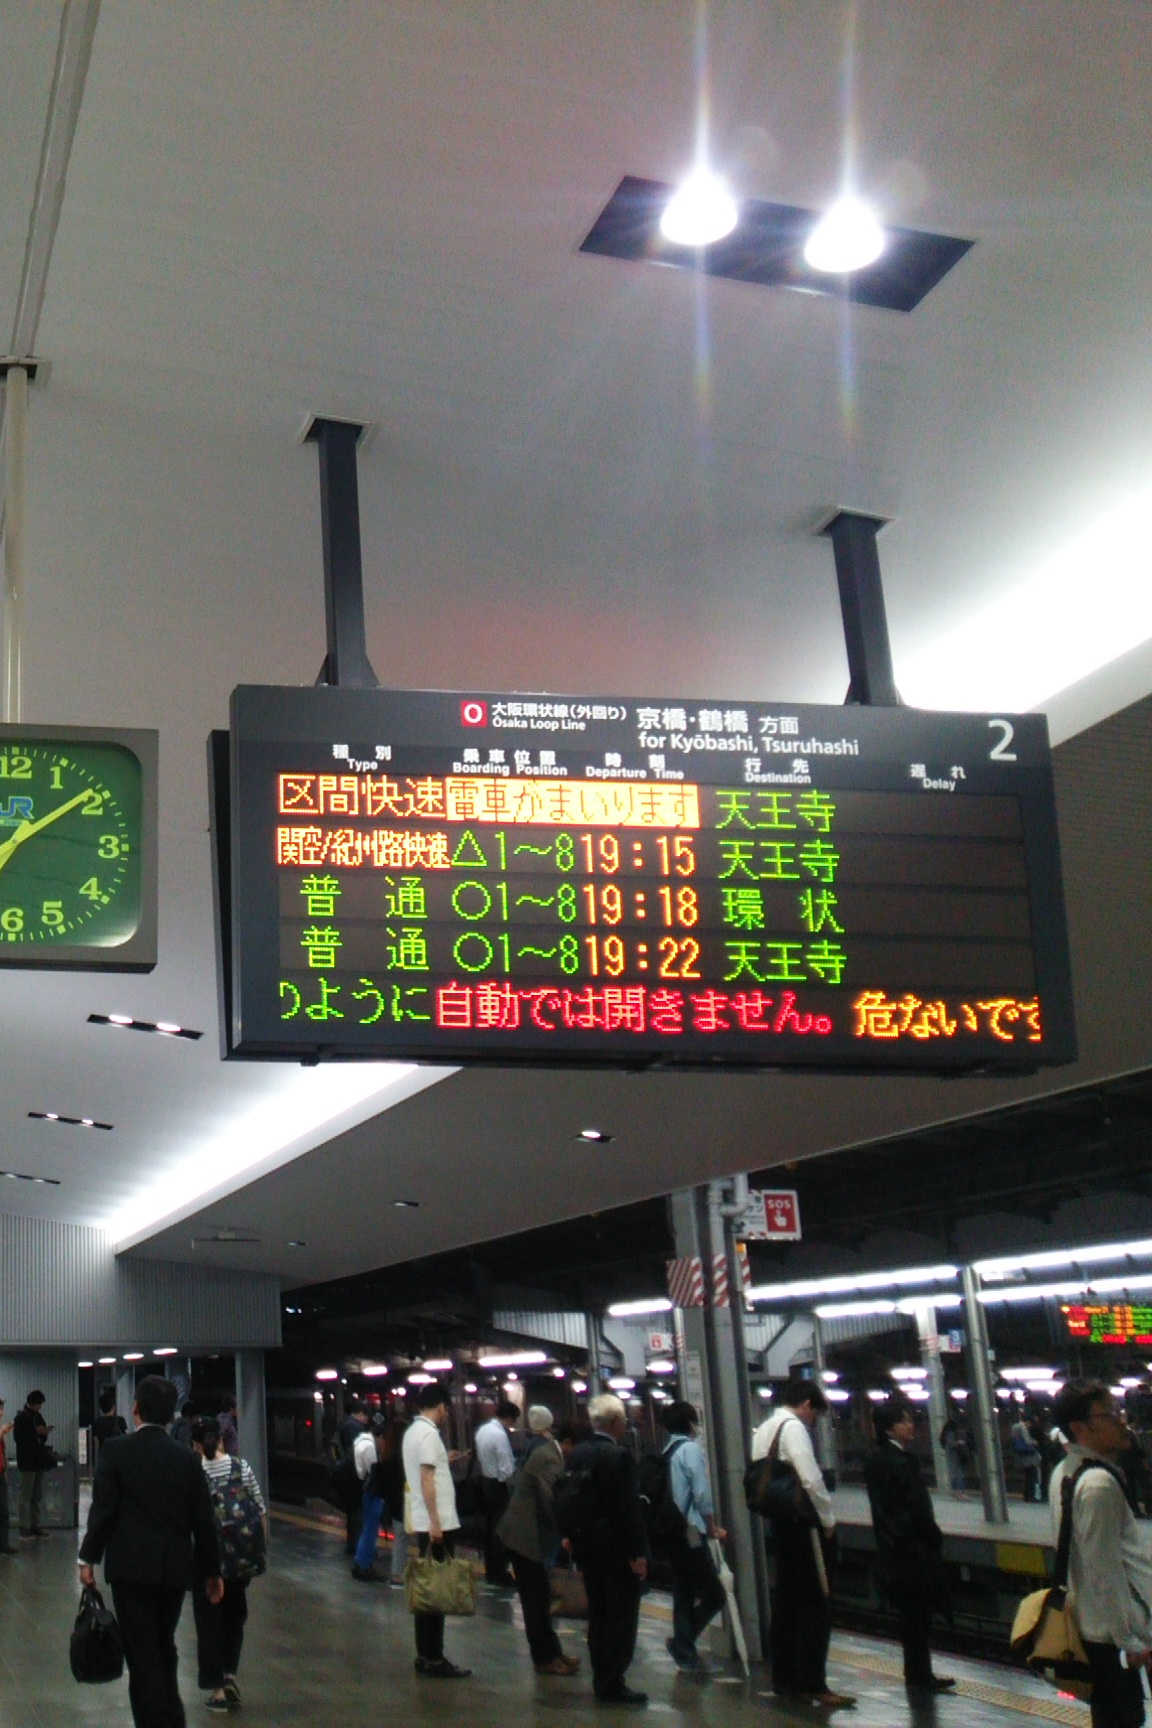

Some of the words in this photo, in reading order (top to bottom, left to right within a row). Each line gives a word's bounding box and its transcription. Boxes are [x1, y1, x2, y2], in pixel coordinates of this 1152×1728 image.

[530, 719, 559, 731] Loop
[562, 719, 586, 730] Line
[759, 716, 799, 735] 方面
[638, 731, 666, 749] for
[671, 733, 759, 754] Kyōbashi,
[762, 736, 859, 756] Tsuruhashi
[987, 719, 1018, 761] 2
[50, 766, 64, 789] 1
[347, 758, 378, 772] Type
[452, 762, 510, 776] Boarding
[516, 763, 568, 777] Position
[585, 765, 647, 779] Departure
[654, 767, 684, 780] Time
[745, 771, 811, 785] Destination
[922, 777, 956, 792] Delay
[81, 792, 103, 815] 2
[278, 773, 447, 818] 区間快速
[448, 777, 698, 827] 電車がまいります
[715, 788, 836, 832] 天王寺
[98, 835, 120, 858] 3
[580, 833, 696, 876] 19:15
[717, 838, 840, 882] 天王寺
[79, 877, 102, 900] 4
[41, 901, 64, 925] 5
[583, 883, 698, 927] 19:18
[1, 907, 24, 932] 6
[585, 934, 701, 979] 19:22
[723, 939, 847, 984] 天王寺
[767, 1199, 792, 1209] SOS
